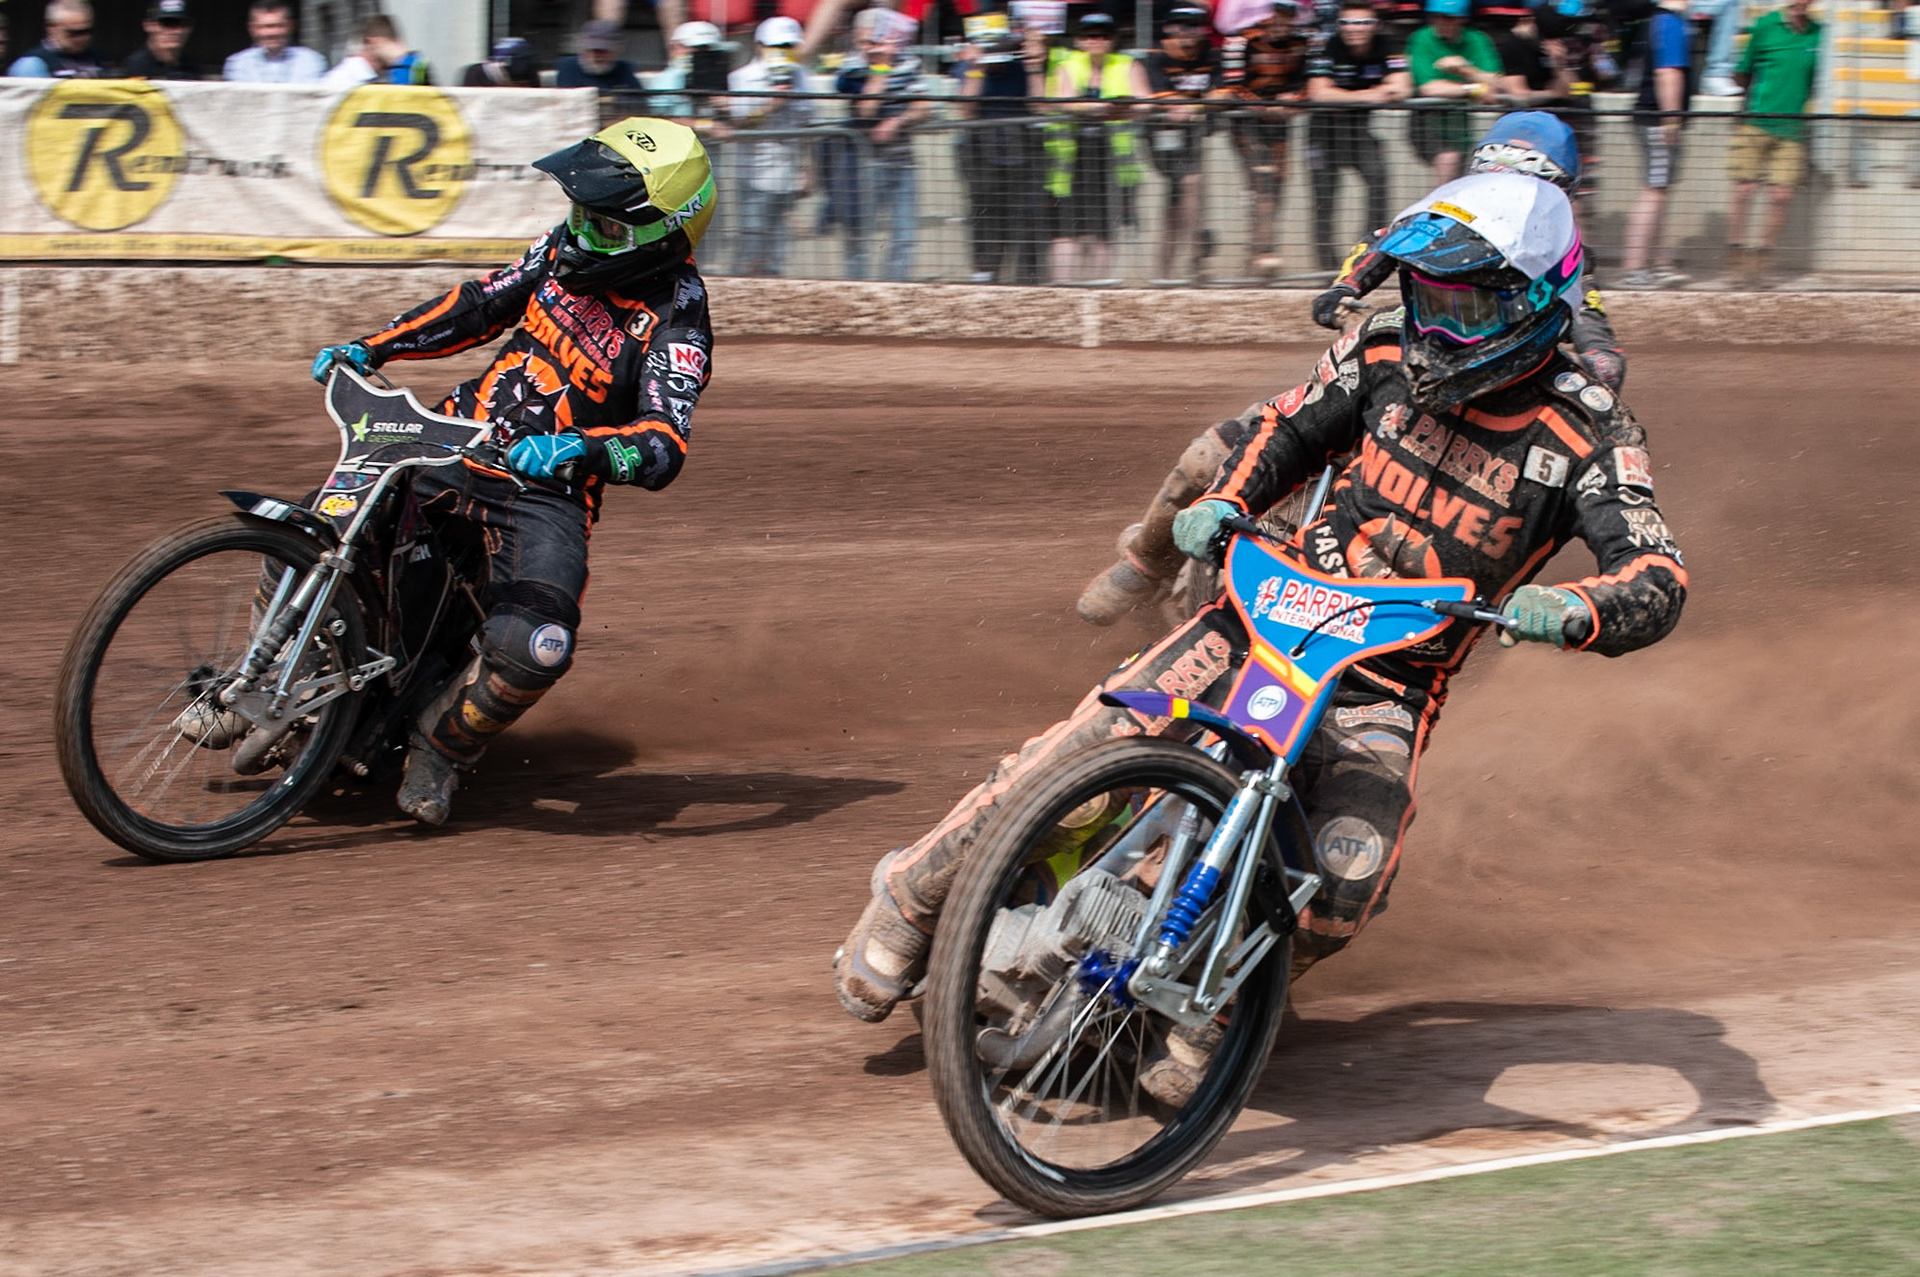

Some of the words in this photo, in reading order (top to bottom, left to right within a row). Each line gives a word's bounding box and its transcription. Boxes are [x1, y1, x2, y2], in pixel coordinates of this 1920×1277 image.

[559, 292, 626, 359] PARRYS
[630, 311, 650, 335] 3
[371, 422, 424, 434] STELLAR
[1410, 414, 1520, 493] PARRYS
[1539, 453, 1556, 482] 5
[1361, 432, 1524, 559] WOLVES
[1280, 582, 1373, 627] PARRYS
[538, 638, 564, 652] ATP
[1254, 696, 1279, 710] ATP
[1326, 836, 1372, 861] ATP
